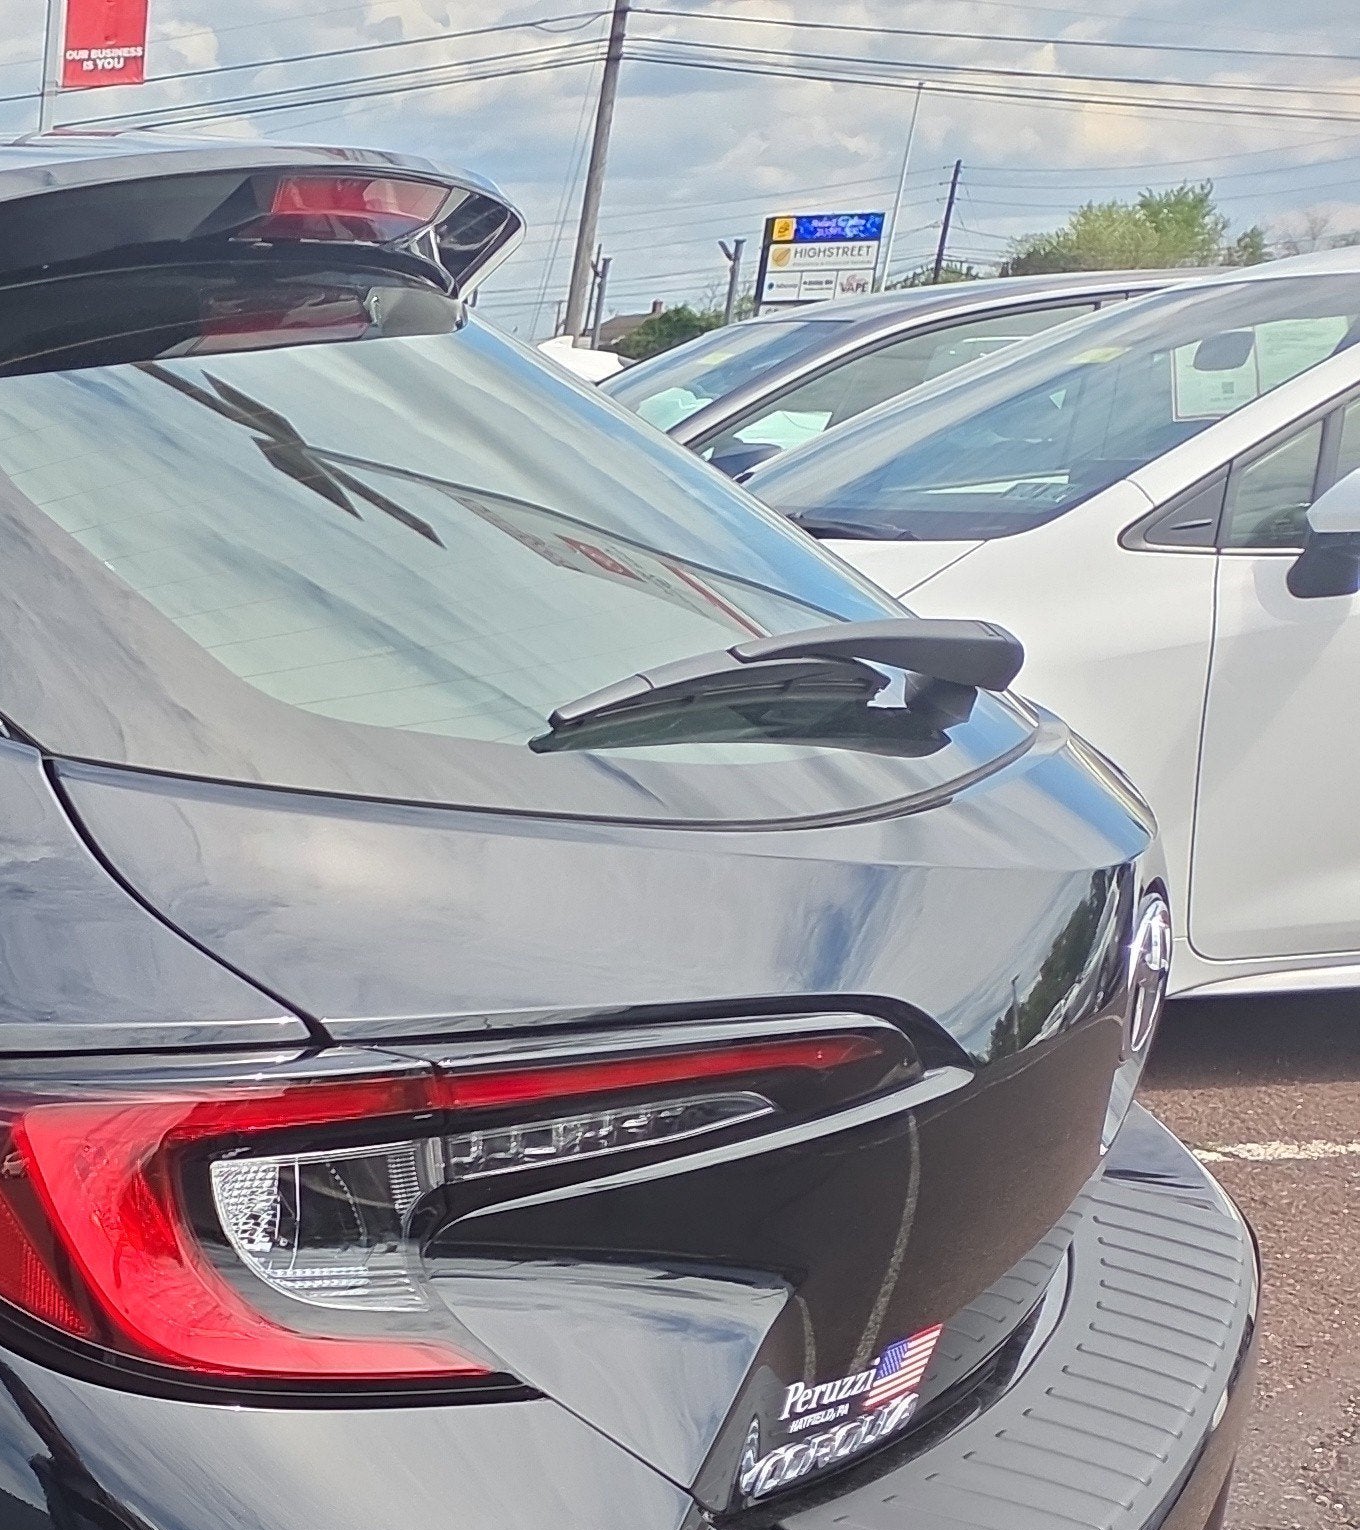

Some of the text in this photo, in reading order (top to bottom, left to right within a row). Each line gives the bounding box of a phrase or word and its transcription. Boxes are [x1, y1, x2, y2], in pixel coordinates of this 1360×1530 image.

[66, 47, 143, 60] OUR BUSINESS
[82, 57, 125, 71] IS YOU
[794, 245, 872, 259] HIGHSTREET
[778, 1357, 881, 1421] Peruzzi
